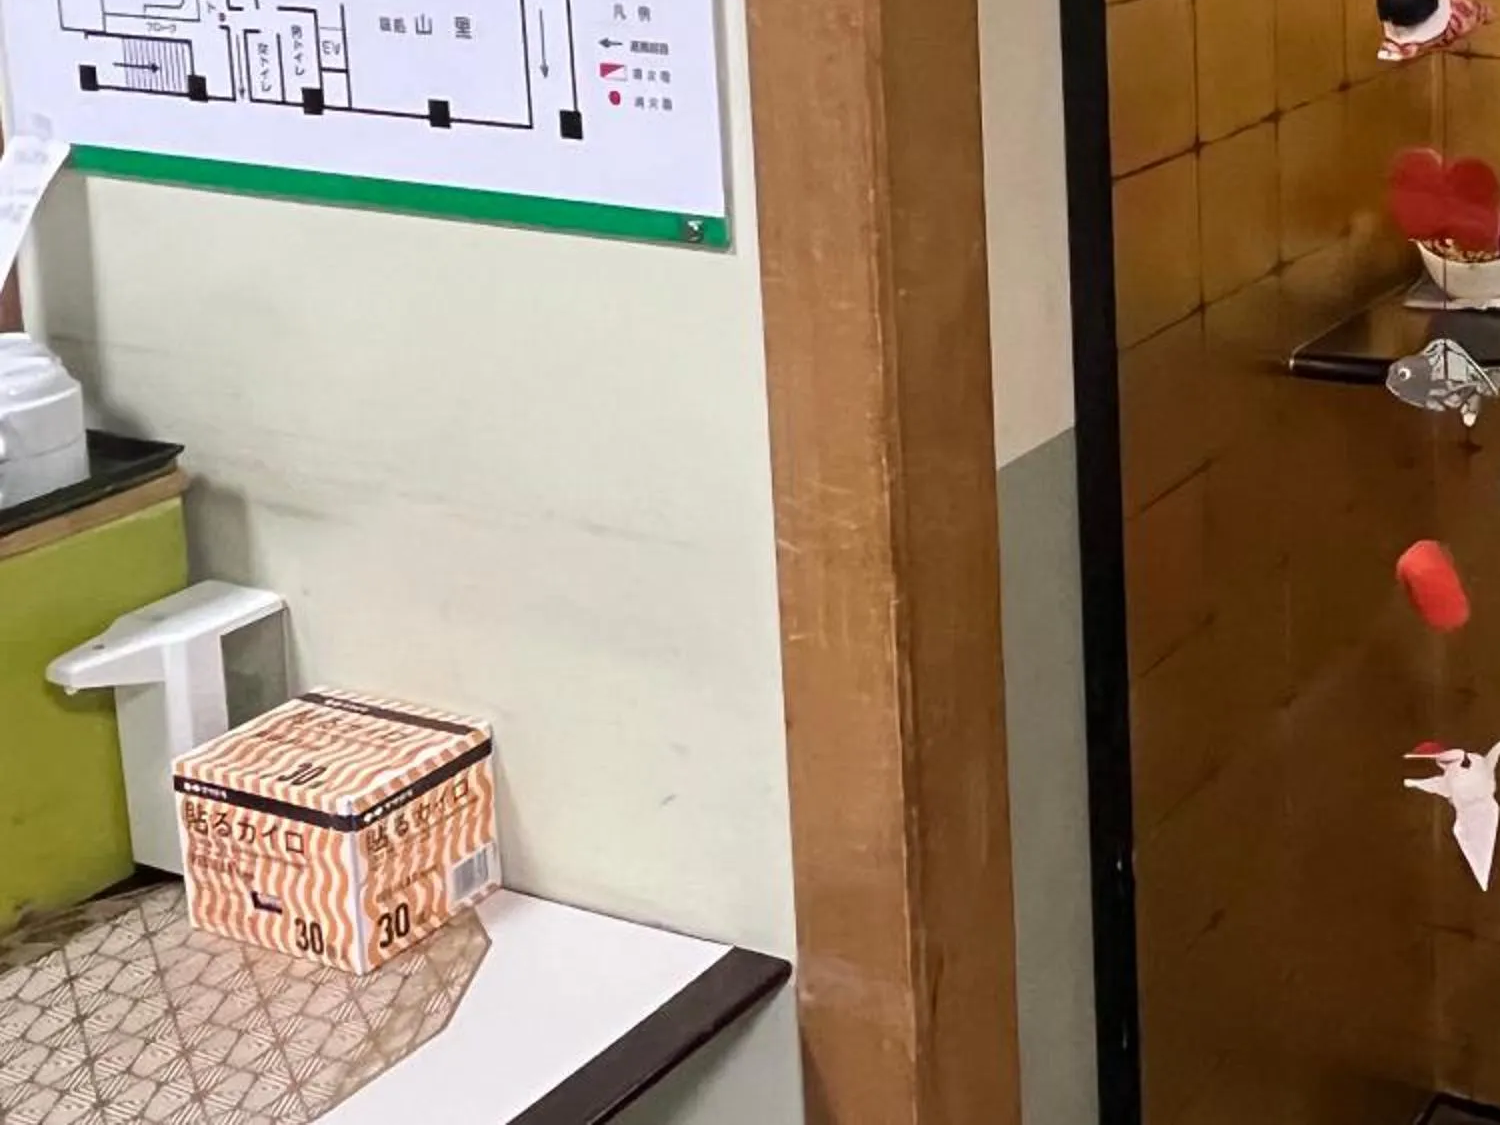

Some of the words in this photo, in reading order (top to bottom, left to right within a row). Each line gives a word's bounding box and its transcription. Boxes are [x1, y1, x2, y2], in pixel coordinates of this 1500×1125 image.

[184, 800, 305, 854] 貼るカイロ
[294, 918, 325, 956] 30
[377, 902, 411, 949] 30
